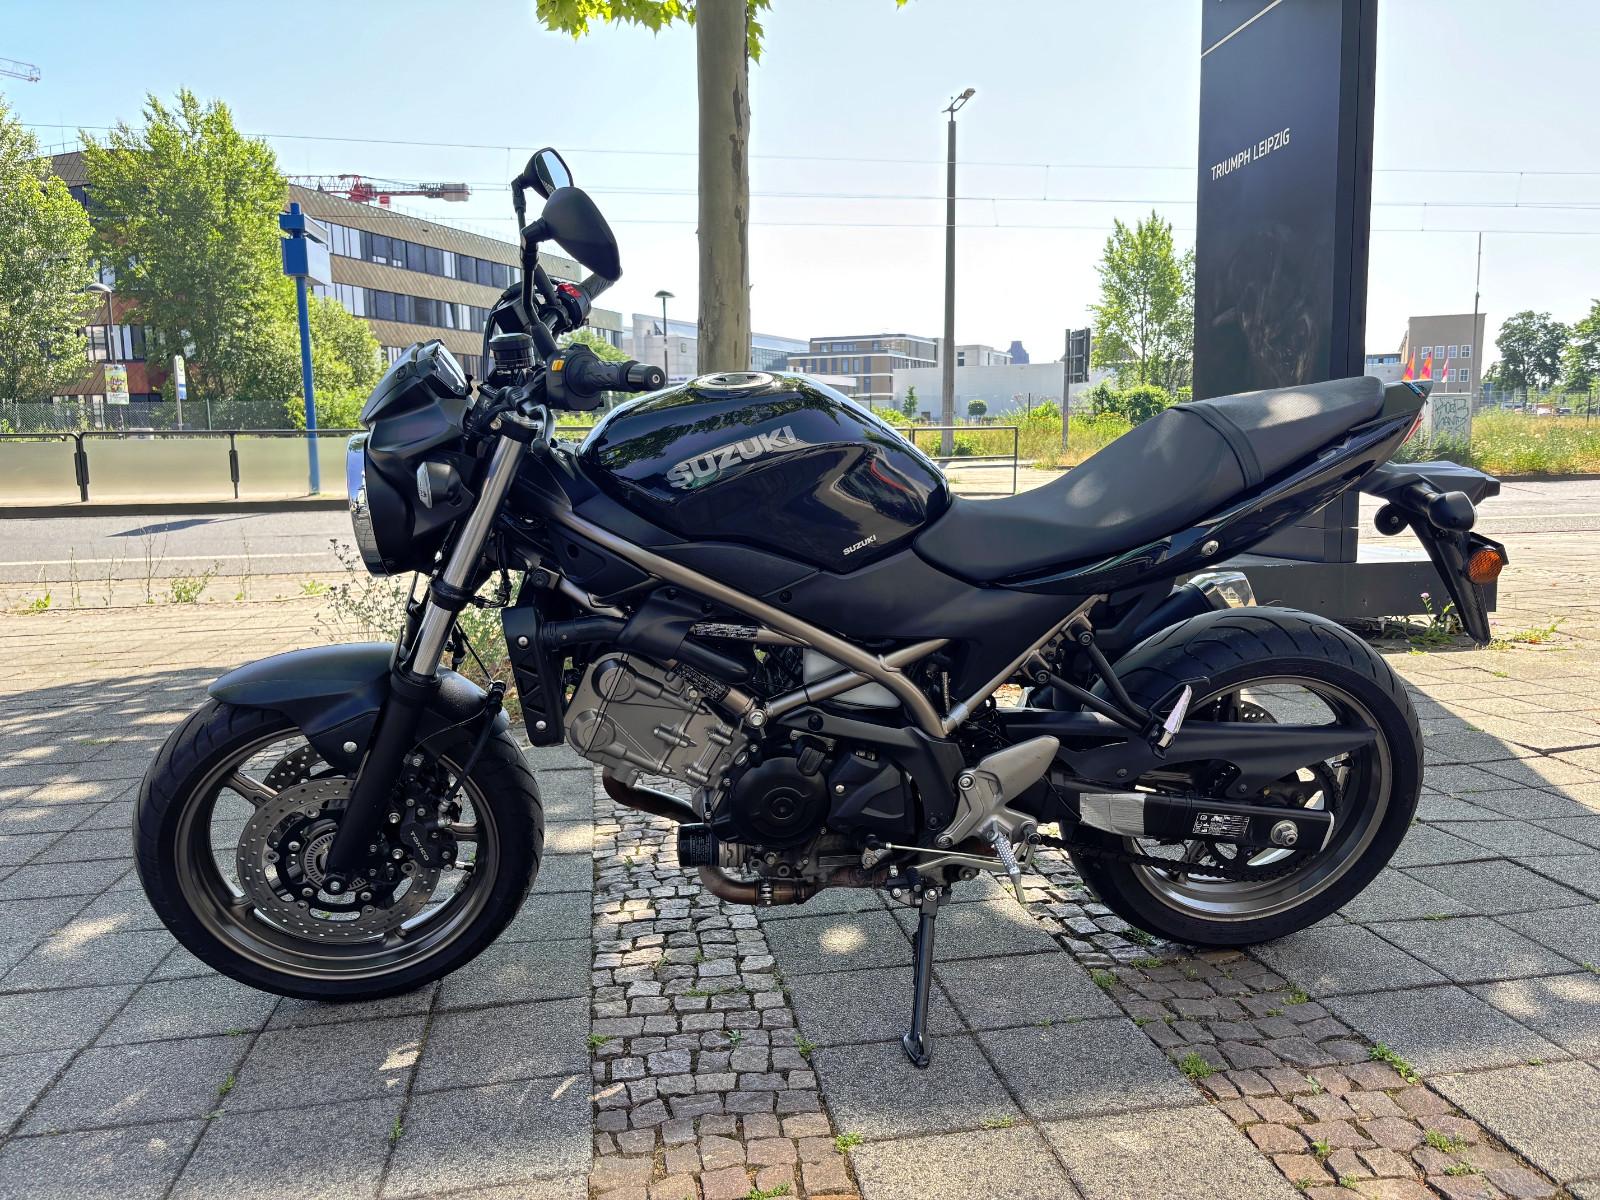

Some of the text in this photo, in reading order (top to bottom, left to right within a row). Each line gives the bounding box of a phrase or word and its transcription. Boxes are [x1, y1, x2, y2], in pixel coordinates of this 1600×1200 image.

[1211, 127, 1290, 181] TRIUMPH LEIPZIG
[666, 425, 797, 490] SUZUKI
[843, 534, 876, 556] SUZUKI
[410, 830, 430, 861] TOKICO
